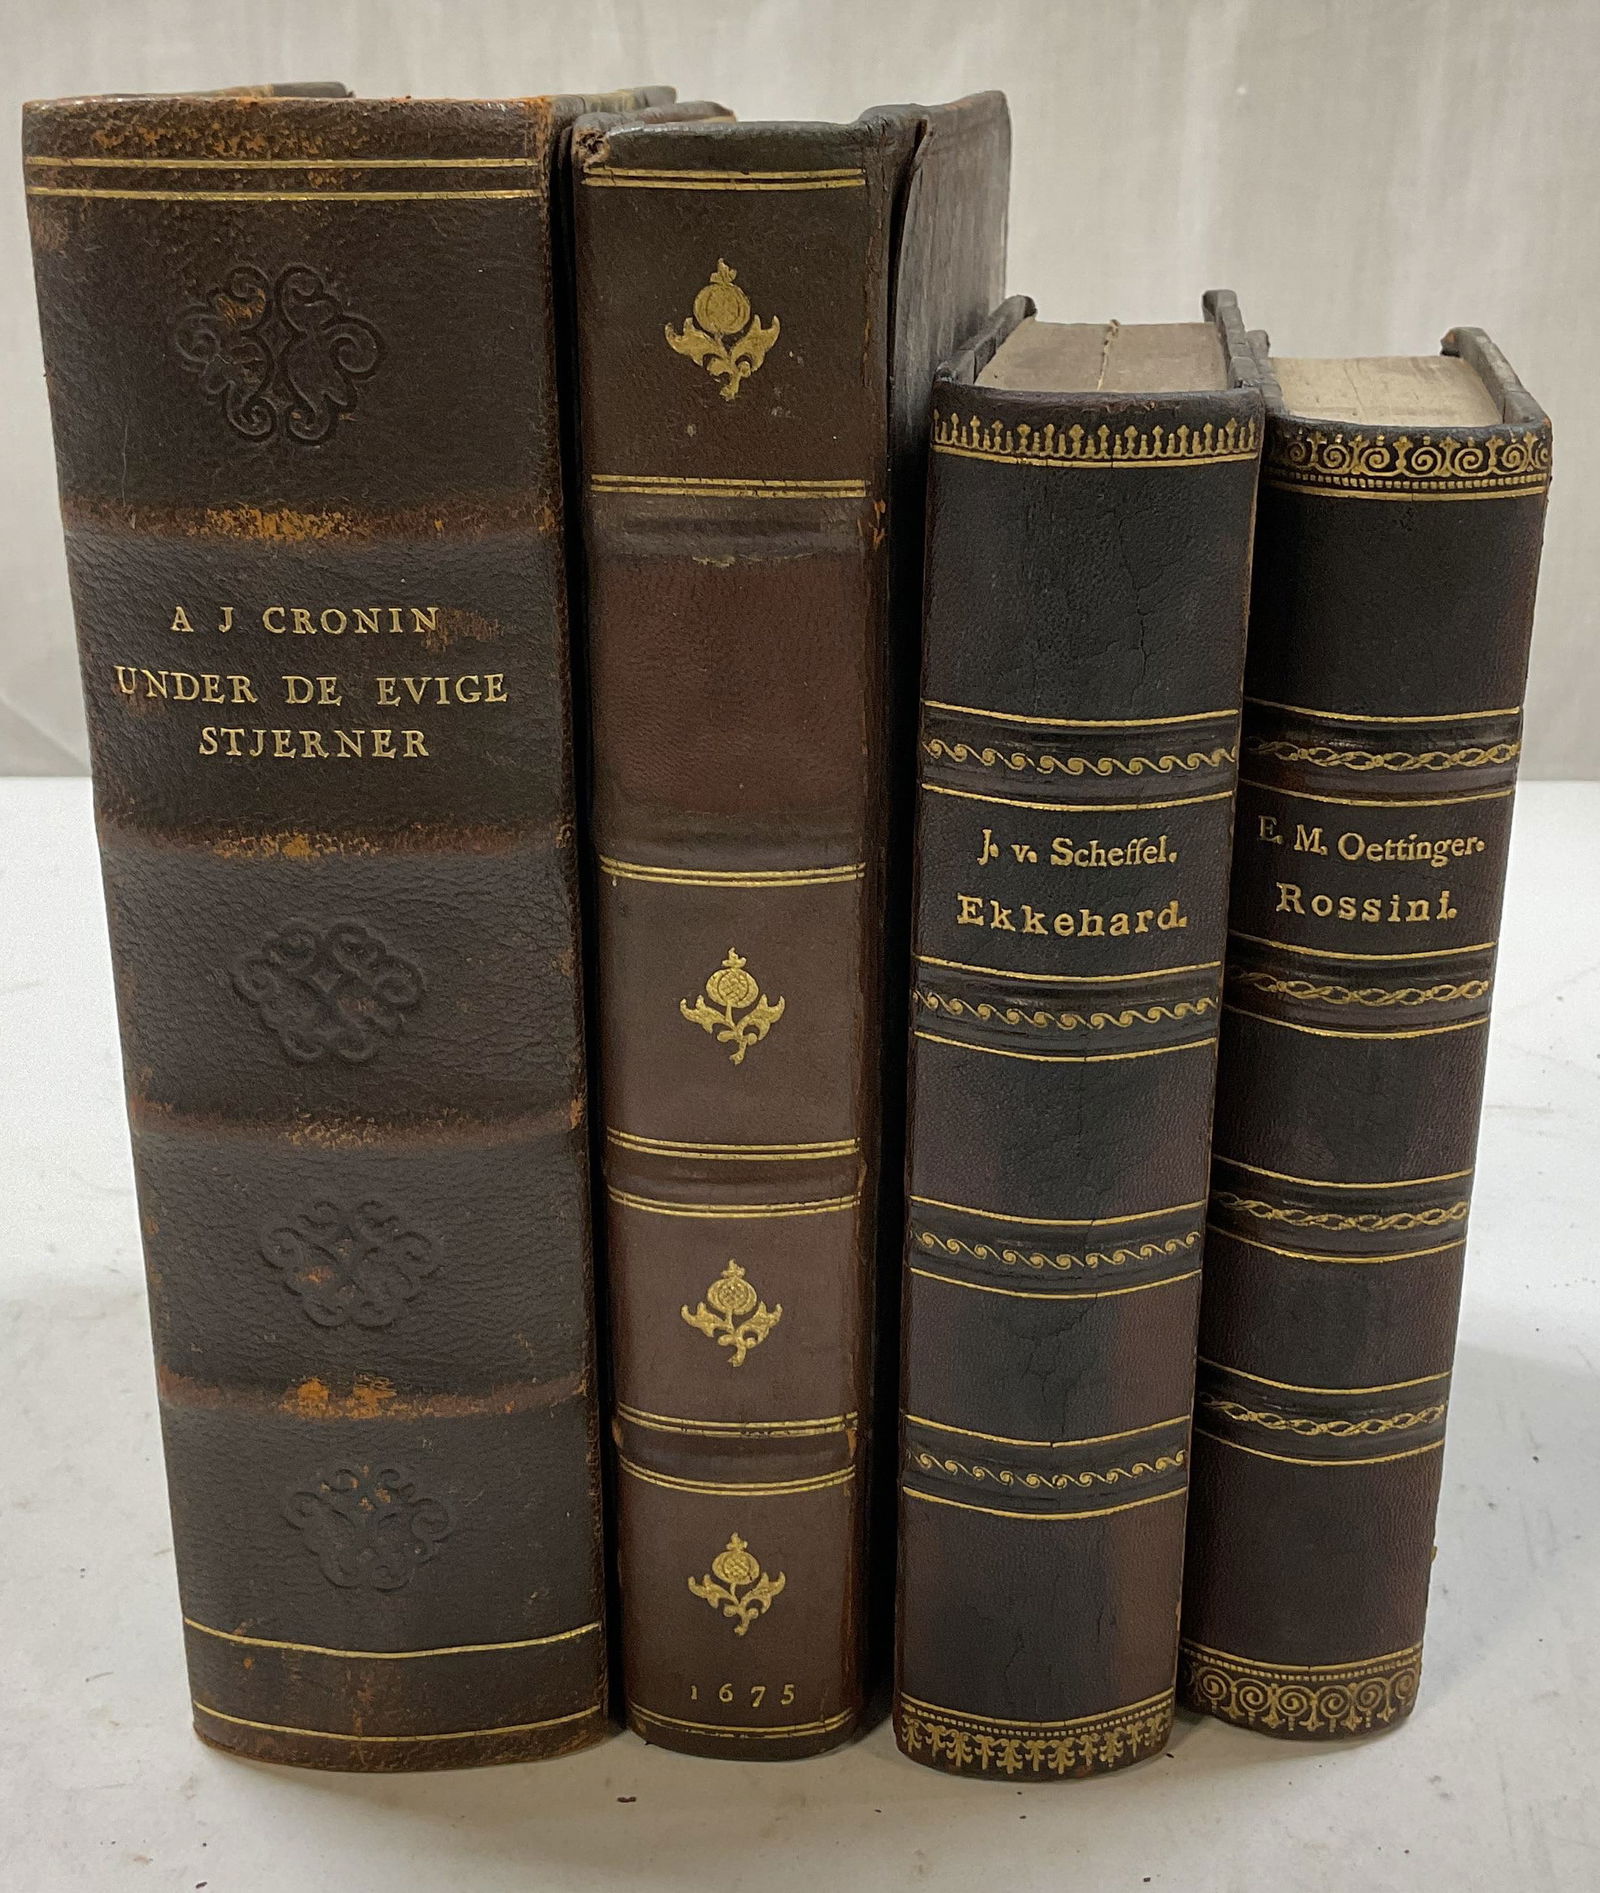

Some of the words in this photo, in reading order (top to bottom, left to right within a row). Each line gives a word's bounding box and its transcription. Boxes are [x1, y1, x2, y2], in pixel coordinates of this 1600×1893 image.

[170, 606, 194, 633] A
[219, 606, 234, 633] J
[262, 606, 439, 635] CRONIN
[114, 666, 258, 704] UNDER
[282, 674, 342, 706] DE
[377, 673, 509, 707] EVIGE
[199, 726, 430, 759] STJERNER
[976, 829, 999, 865] J.
[1011, 844, 1038, 863] v.
[1050, 835, 1178, 868] Scheffel.
[1294, 824, 1328, 856] M.
[1337, 832, 1486, 868] Oettinger.
[956, 892, 1189, 937] Ekkehard.
[1275, 881, 1458, 923] Rossini.
